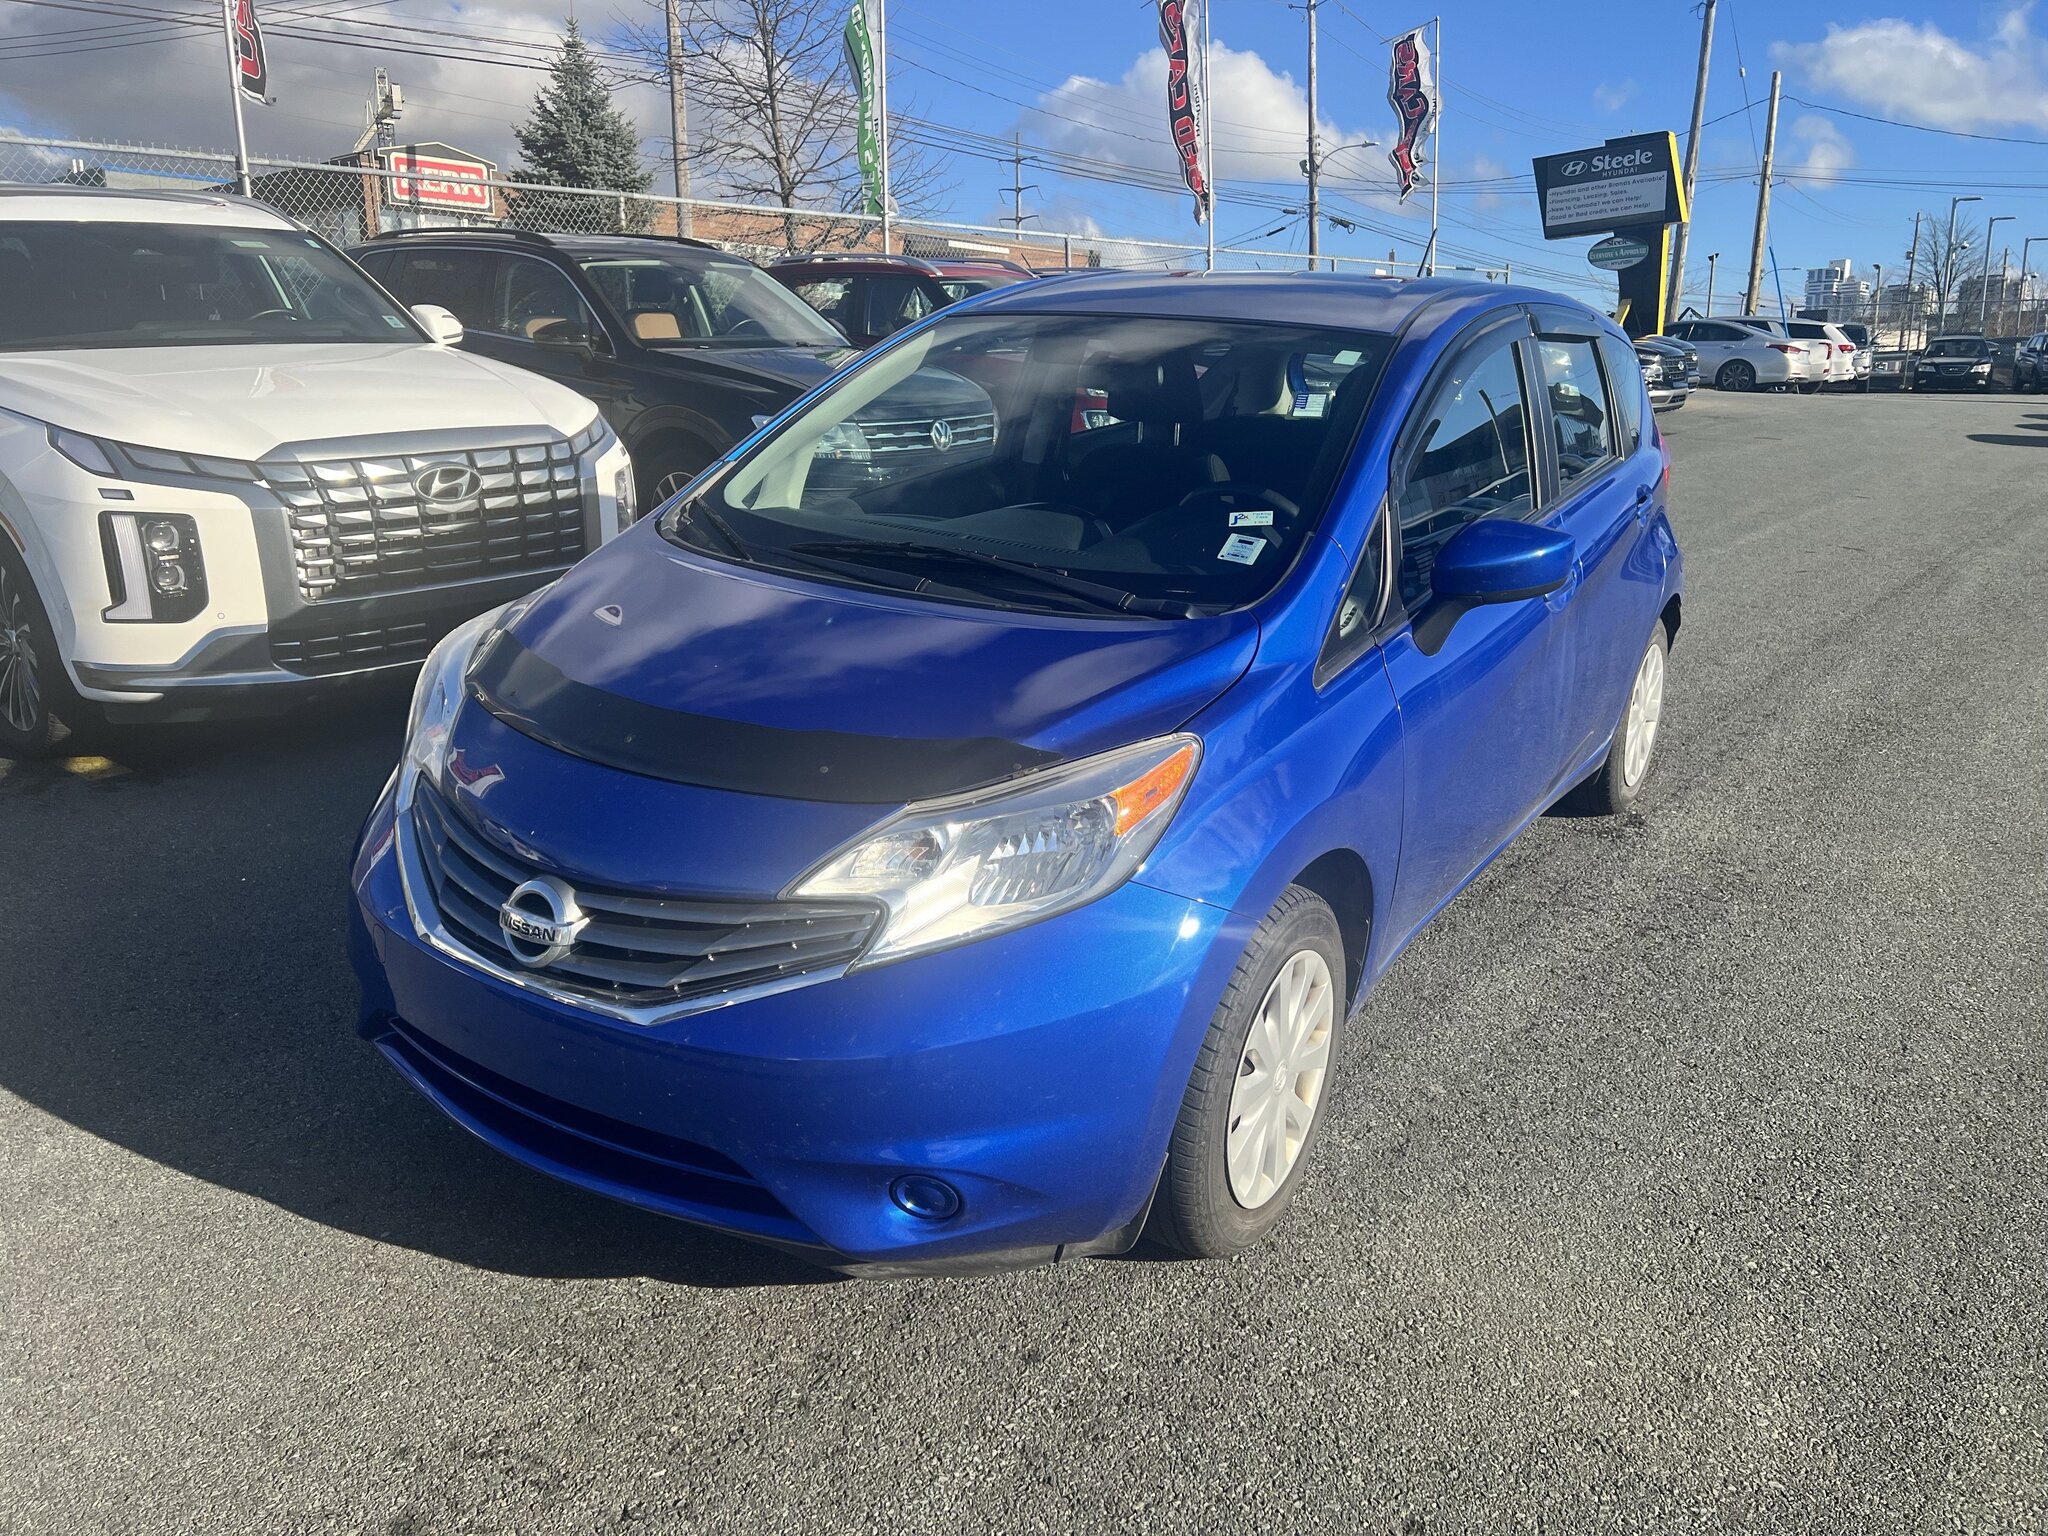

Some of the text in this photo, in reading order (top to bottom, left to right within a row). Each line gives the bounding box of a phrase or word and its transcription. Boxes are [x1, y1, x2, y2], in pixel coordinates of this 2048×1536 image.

[1591, 149, 1653, 172] Steele
[1602, 166, 1638, 178] HYUNDAI
[399, 164, 482, 197] KERR
[1608, 180, 1631, 188] Brands
[501, 909, 556, 942] NISSAN
